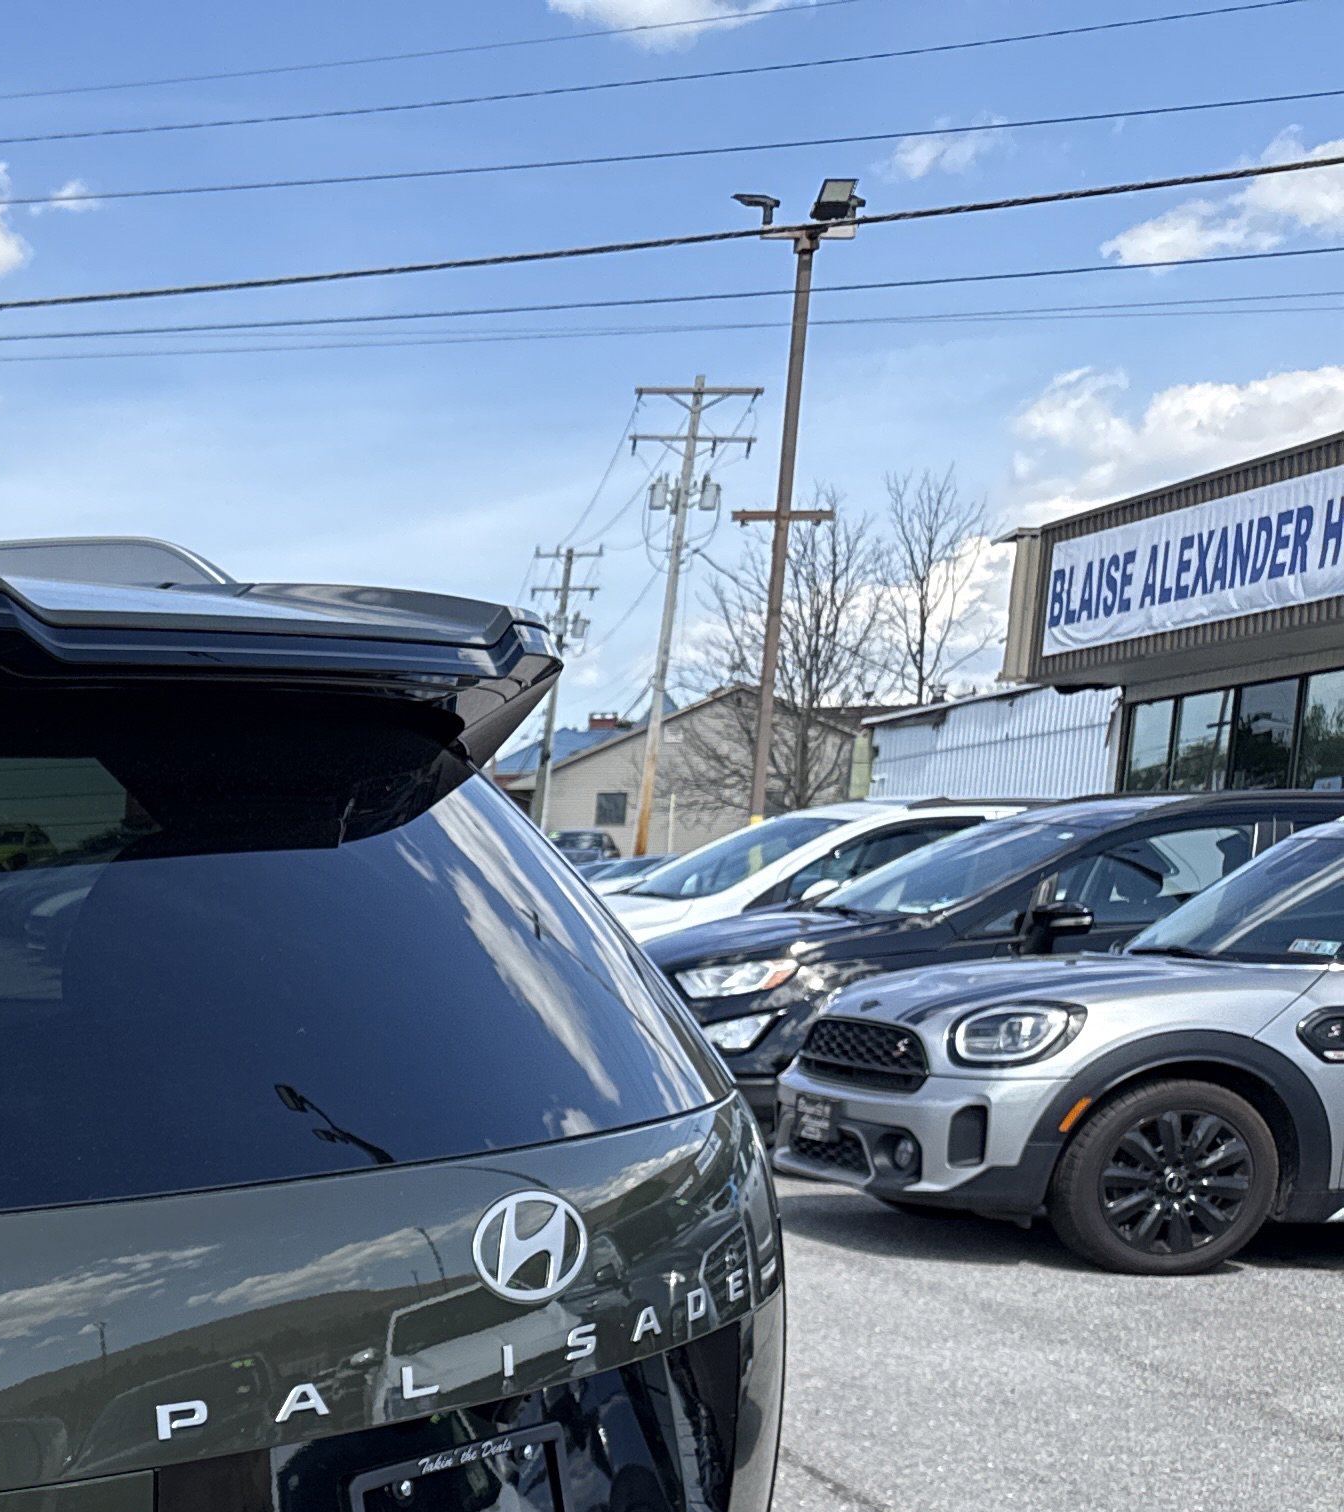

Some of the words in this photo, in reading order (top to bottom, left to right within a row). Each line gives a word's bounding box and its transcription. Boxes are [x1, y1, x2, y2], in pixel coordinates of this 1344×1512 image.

[1048, 550, 1137, 629] BLAISE
[1138, 505, 1314, 609] ALEXANDER
[156, 1268, 745, 1441] PALISADE
[460, 1446, 478, 1464] the
